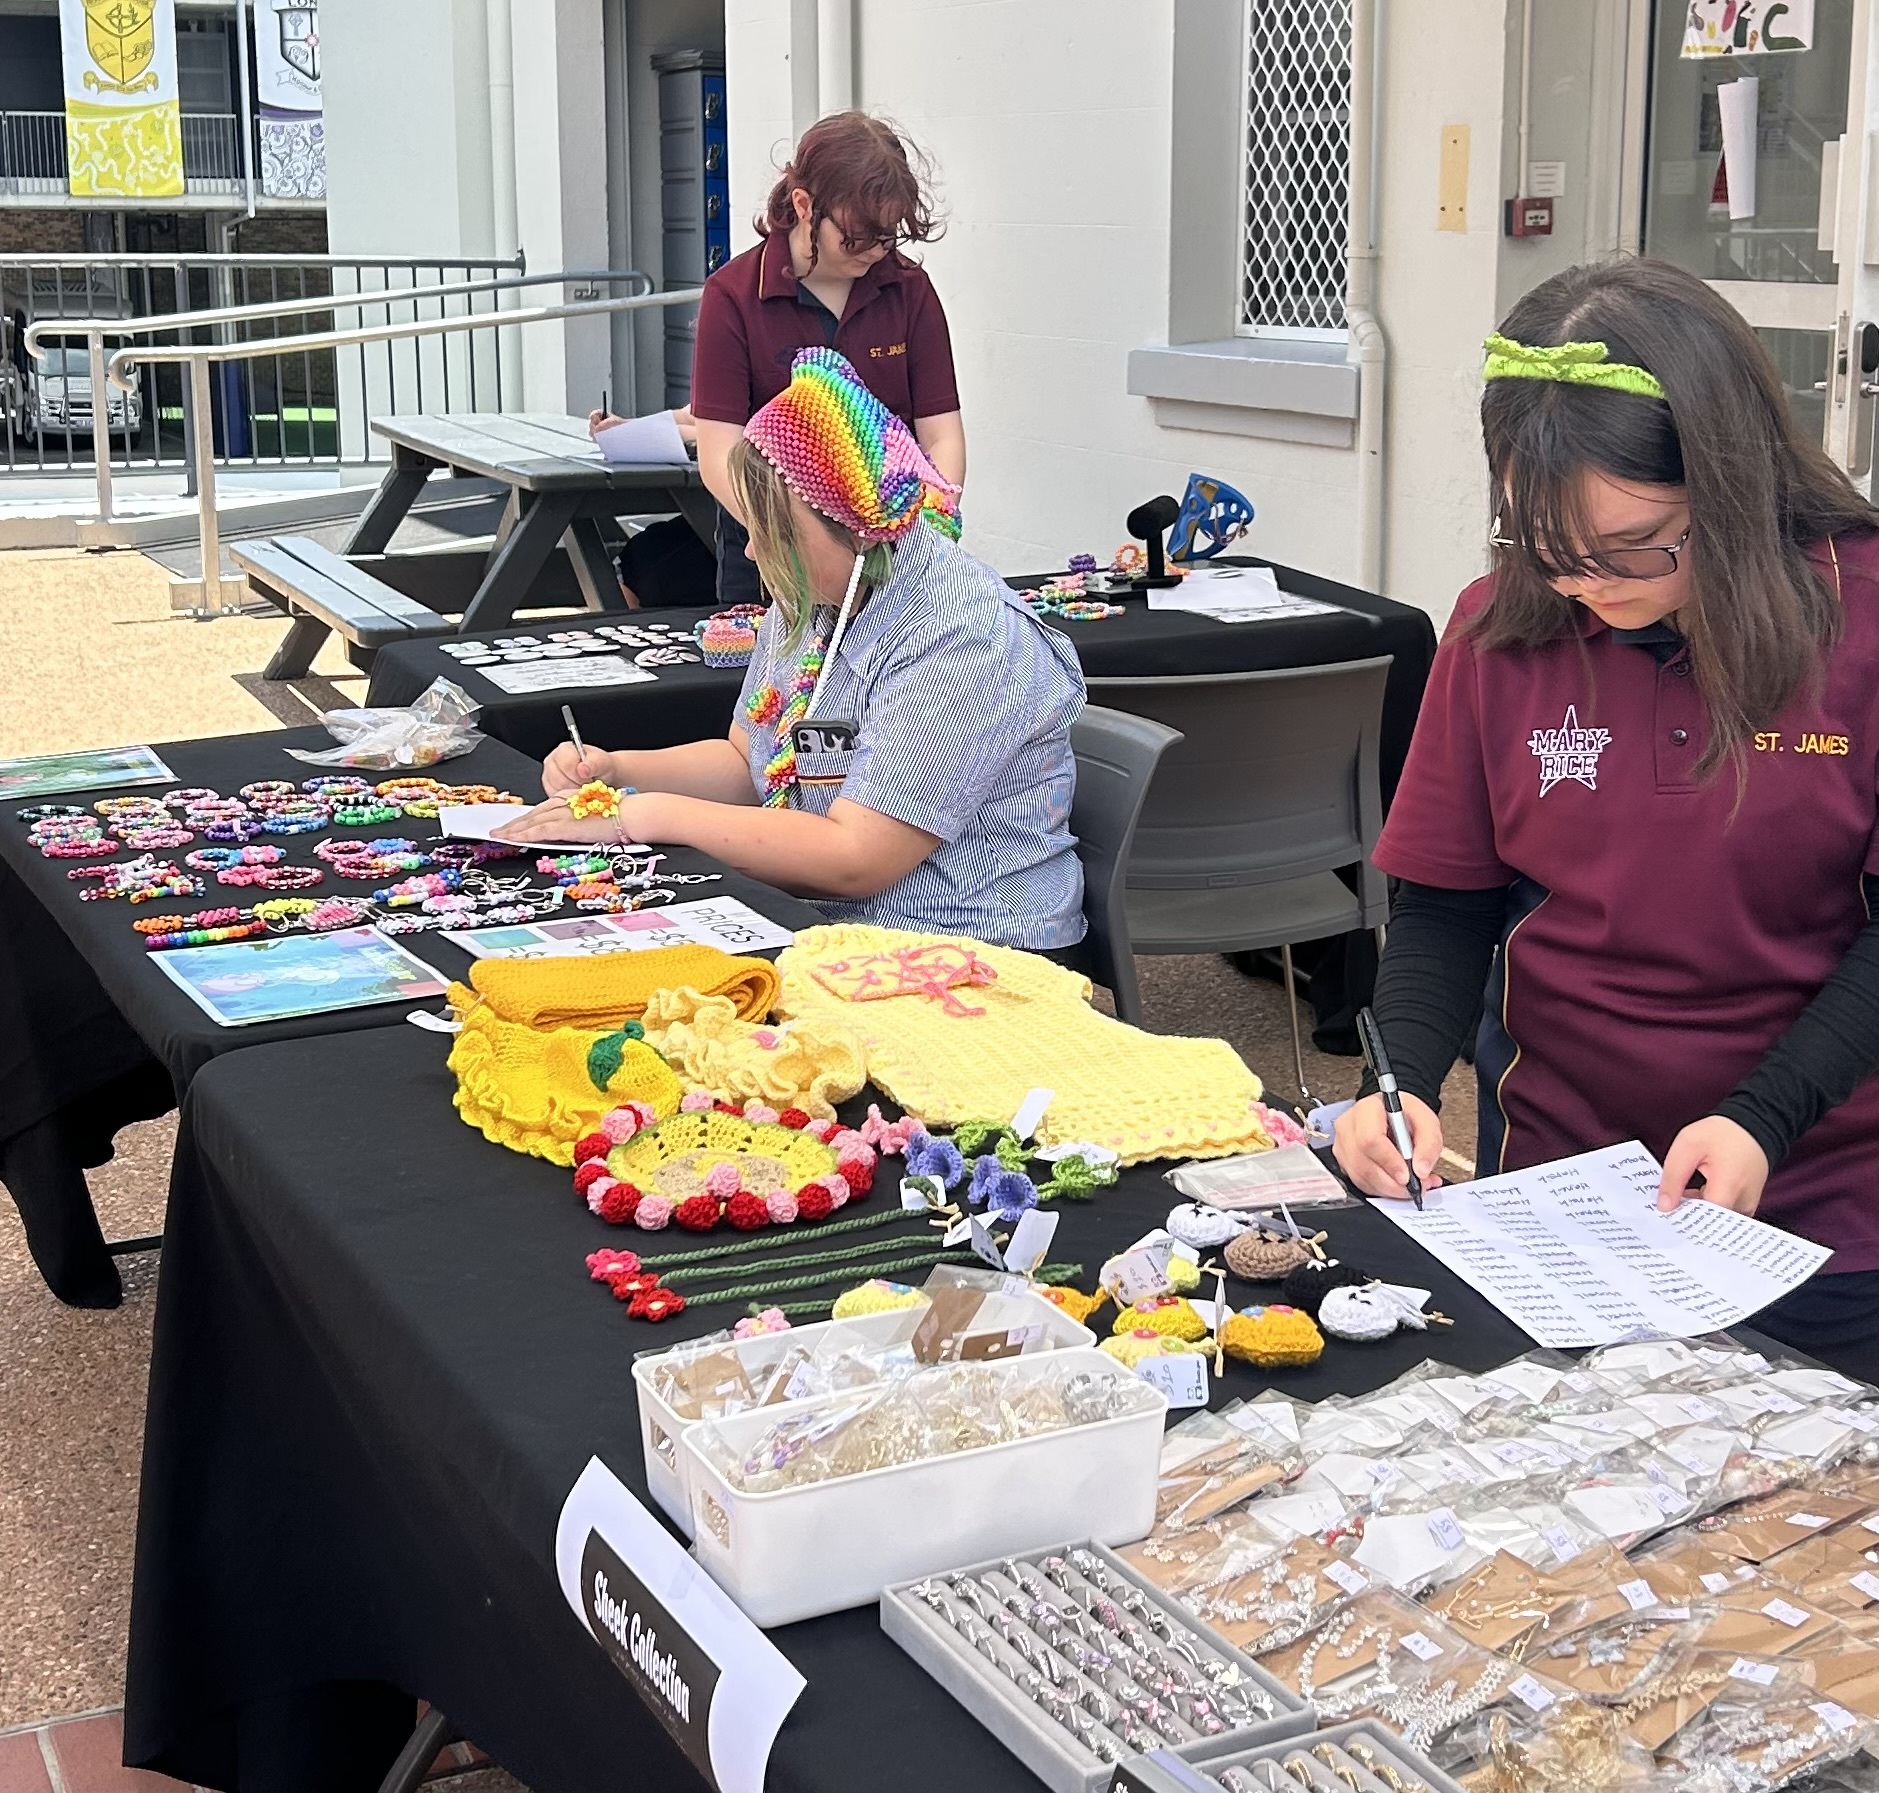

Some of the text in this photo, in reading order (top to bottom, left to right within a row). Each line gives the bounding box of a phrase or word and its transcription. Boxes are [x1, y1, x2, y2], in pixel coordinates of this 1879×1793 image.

[1531, 728, 1610, 755] MARY
[1753, 732, 1850, 757] ST. JAMES
[1538, 754, 1599, 779] RICE
[680, 907, 765, 944] PRICES
[593, 1570, 628, 1650] Sheek
[630, 1612, 690, 1724] Collection
